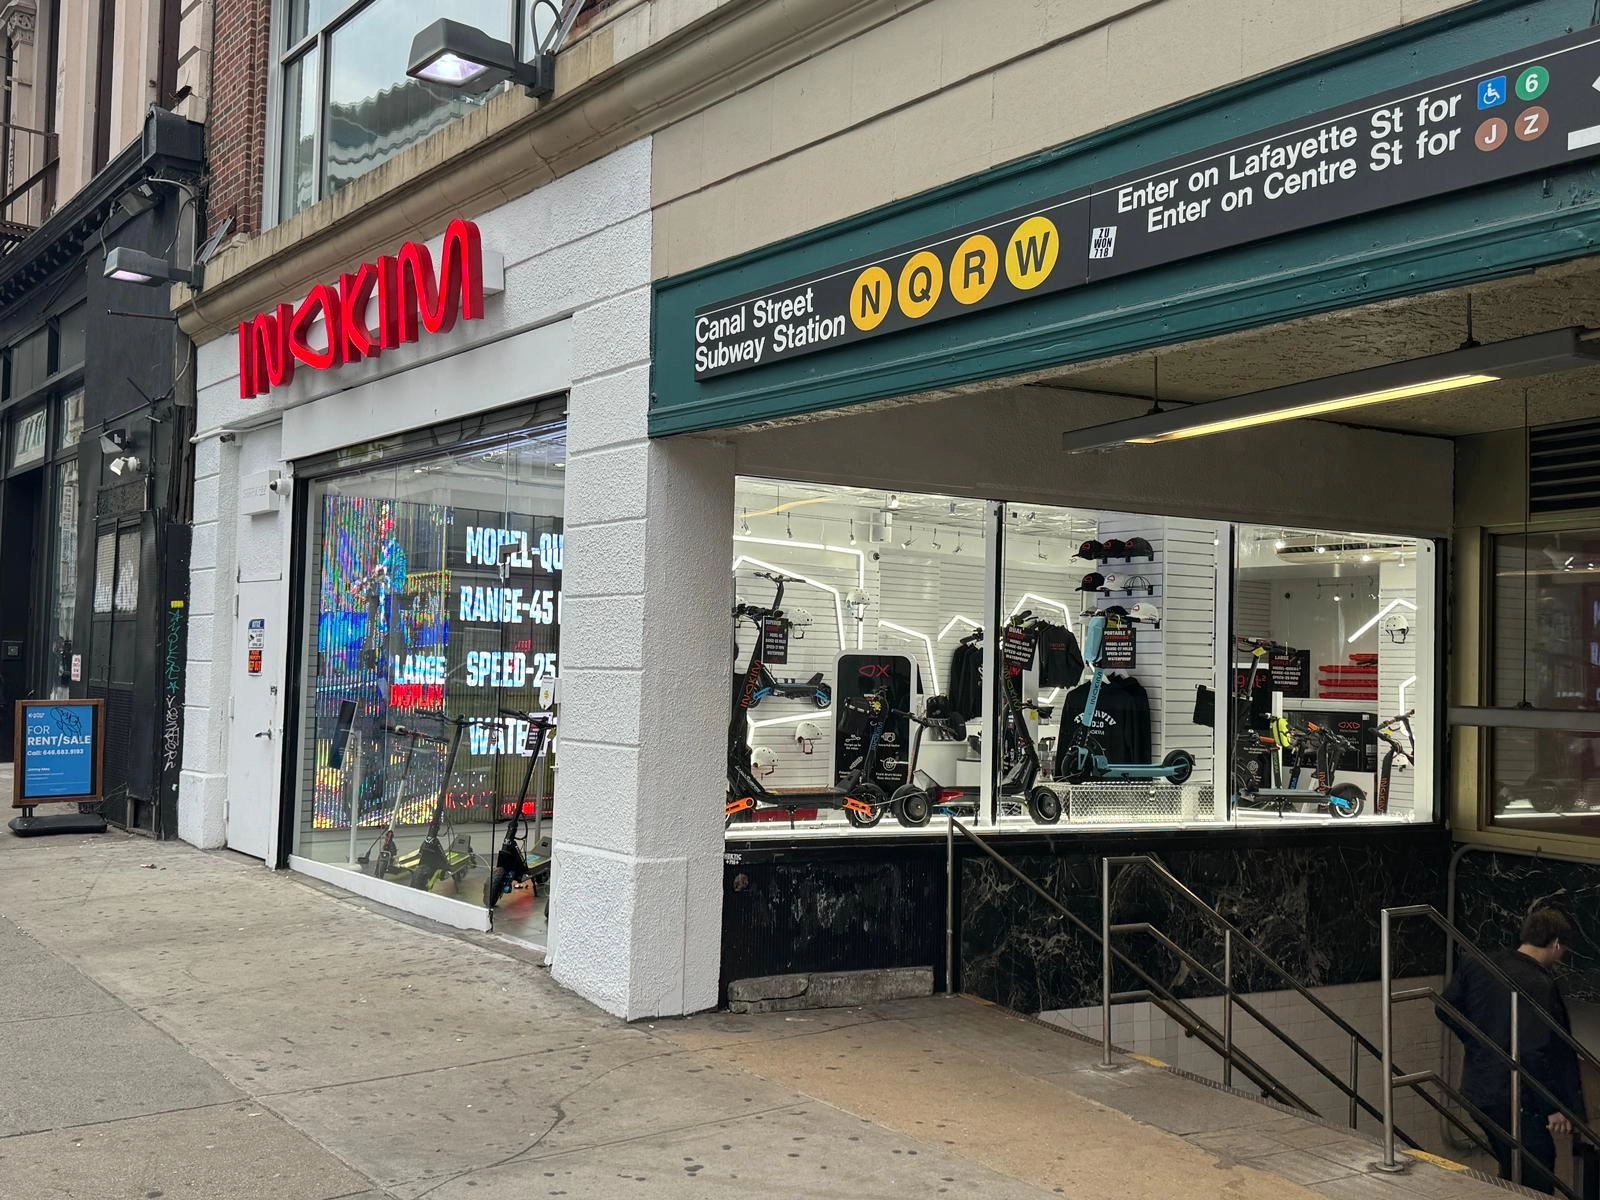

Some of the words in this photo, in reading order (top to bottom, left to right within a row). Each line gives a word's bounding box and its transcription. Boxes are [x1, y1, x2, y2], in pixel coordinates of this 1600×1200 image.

[1118, 178, 1178, 213] Enter
[1188, 167, 1218, 192] on
[1229, 126, 1357, 180] Lafayette
[1370, 107, 1403, 139] St
[1417, 94, 1461, 126] for
[1526, 74, 1538, 92] 6
[1148, 198, 1211, 232] Enter
[1221, 186, 1252, 211] on
[1264, 158, 1356, 199] Centre
[1370, 140, 1403, 171] St
[1416, 127, 1461, 159] for
[1485, 124, 1496, 144] J
[1524, 114, 1538, 135] Z
[1094, 238, 1112, 248] WON
[1095, 248, 1108, 257] 718
[1099, 228, 1109, 238] ZU
[861, 281, 880, 318] N
[909, 266, 932, 303] Q
[964, 250, 985, 289] R
[1015, 232, 1050, 276] W
[239, 218, 484, 399] INOKIM
[696, 306, 745, 343] Canal
[753, 288, 813, 328] Street
[695, 337, 765, 372] Subway
[773, 315, 845, 352] Station
[394, 655, 445, 684] LARGE
[740, 660, 760, 708] INOKIM
[27, 726, 50, 734] FOR
[27, 734, 92, 746] RENT/SALE
